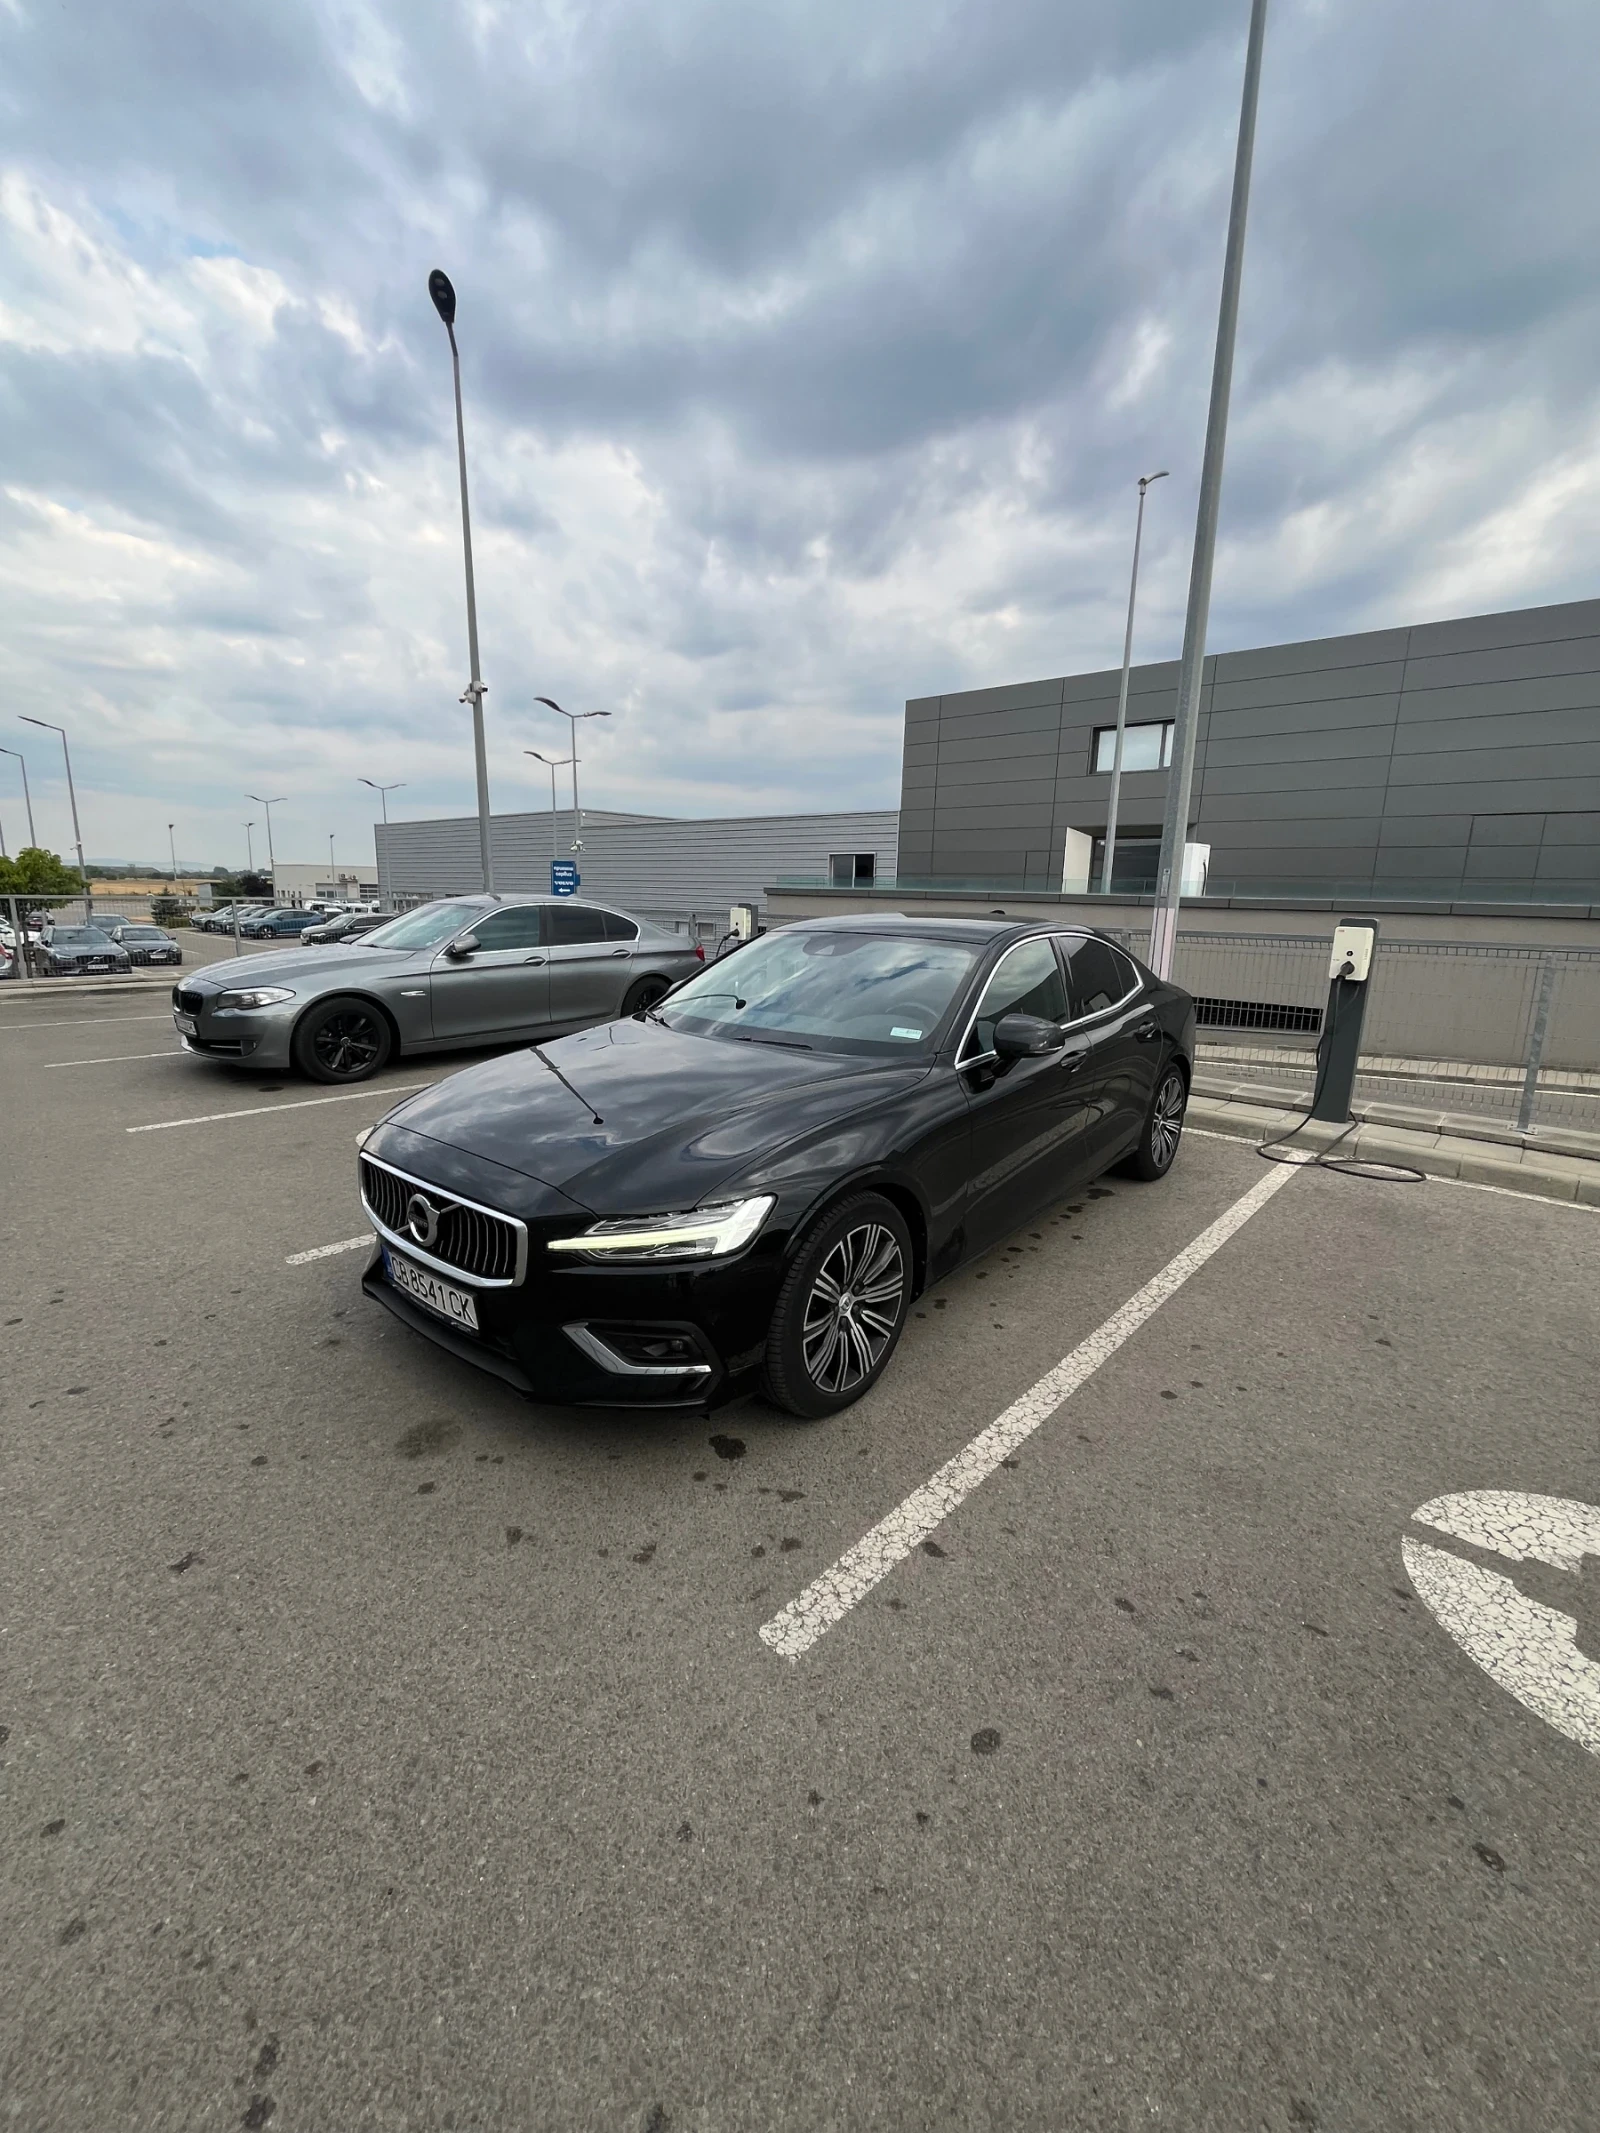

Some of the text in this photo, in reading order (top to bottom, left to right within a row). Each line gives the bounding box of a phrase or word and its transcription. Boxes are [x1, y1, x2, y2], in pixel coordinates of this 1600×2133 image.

[391, 1257, 409, 1286] CB
[411, 1269, 446, 1310] 8541
[449, 1292, 474, 1324] CK
